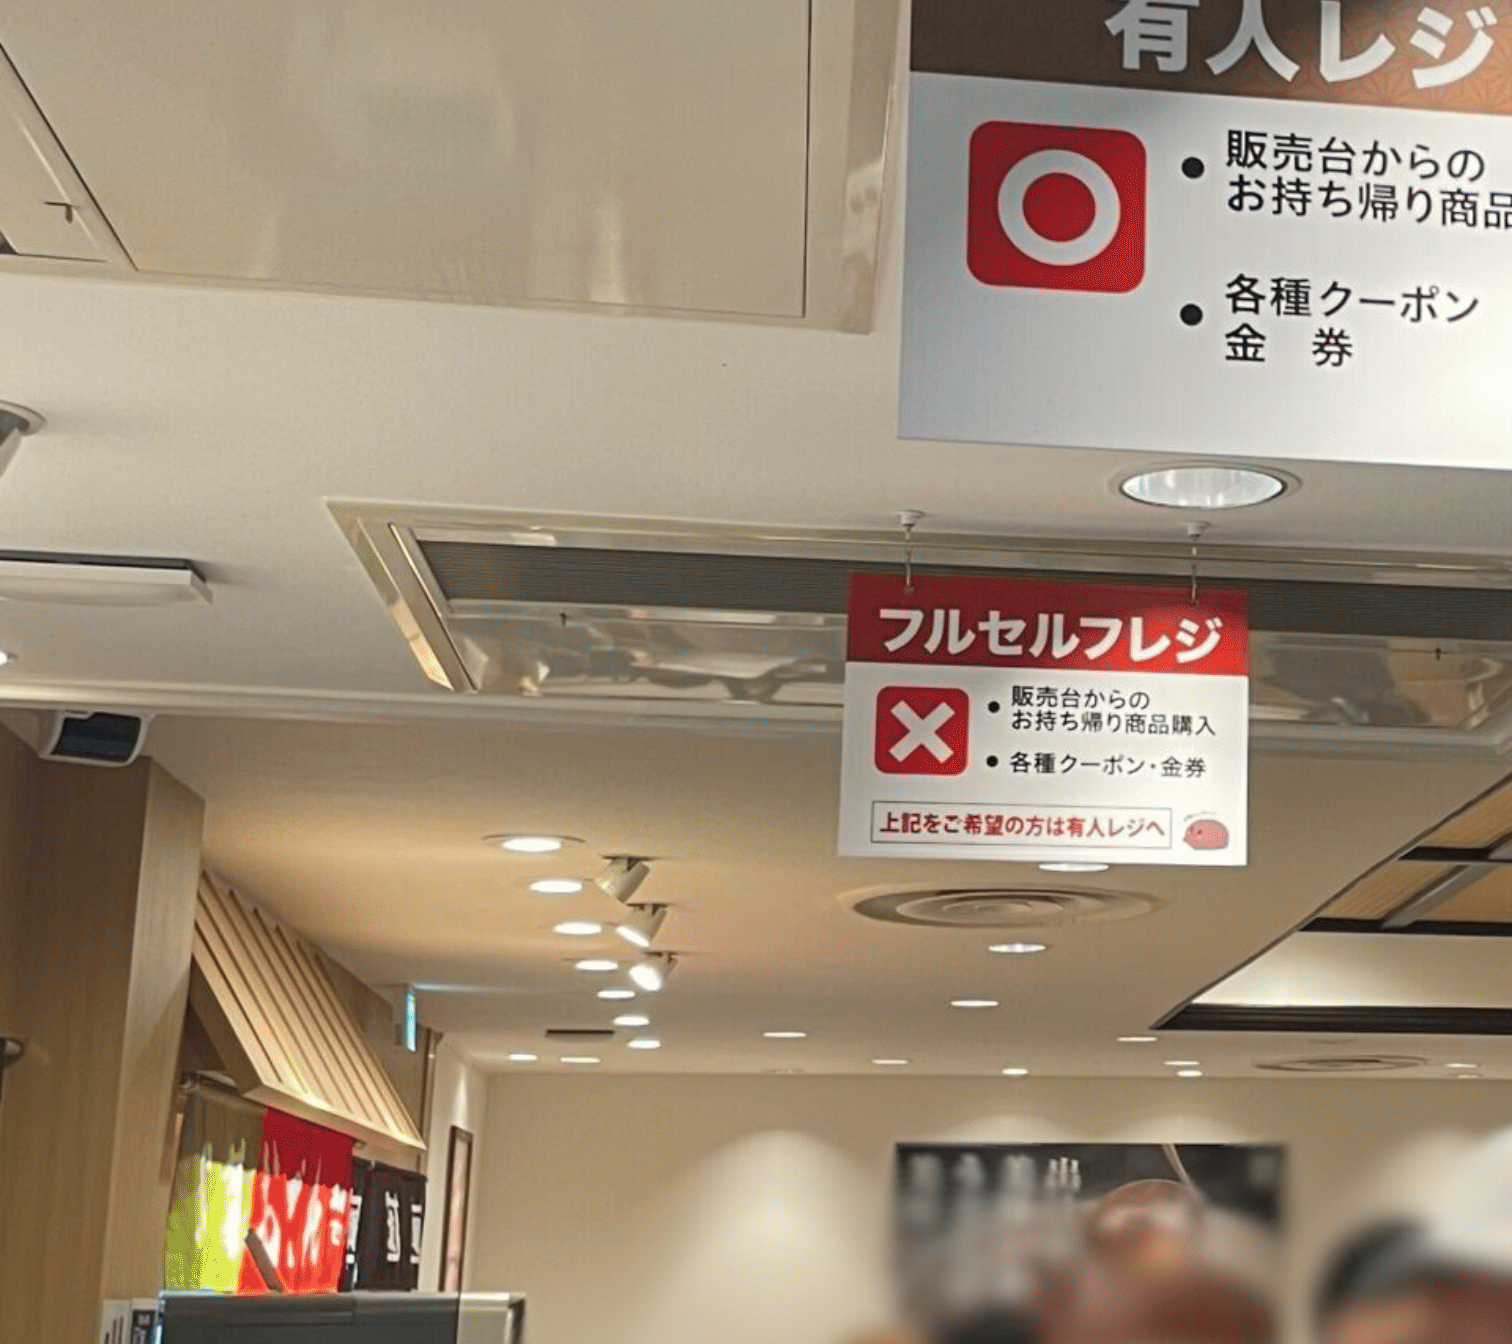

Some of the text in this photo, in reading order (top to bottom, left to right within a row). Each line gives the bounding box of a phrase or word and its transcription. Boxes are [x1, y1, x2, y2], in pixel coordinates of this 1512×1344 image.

[1225, 130, 1486, 181] 販売台からの
[1224, 273, 1480, 324] 各種クーポン
[879, 608, 1223, 663] フルセルフレジ
[1011, 685, 1150, 708] 販売台からの
[1011, 711, 1217, 736] お持ち帰り商品購入
[1010, 752, 1207, 778] 各種クーポン・金券
[879, 812, 1165, 837] 上記をご希望の方は有人レジへ
